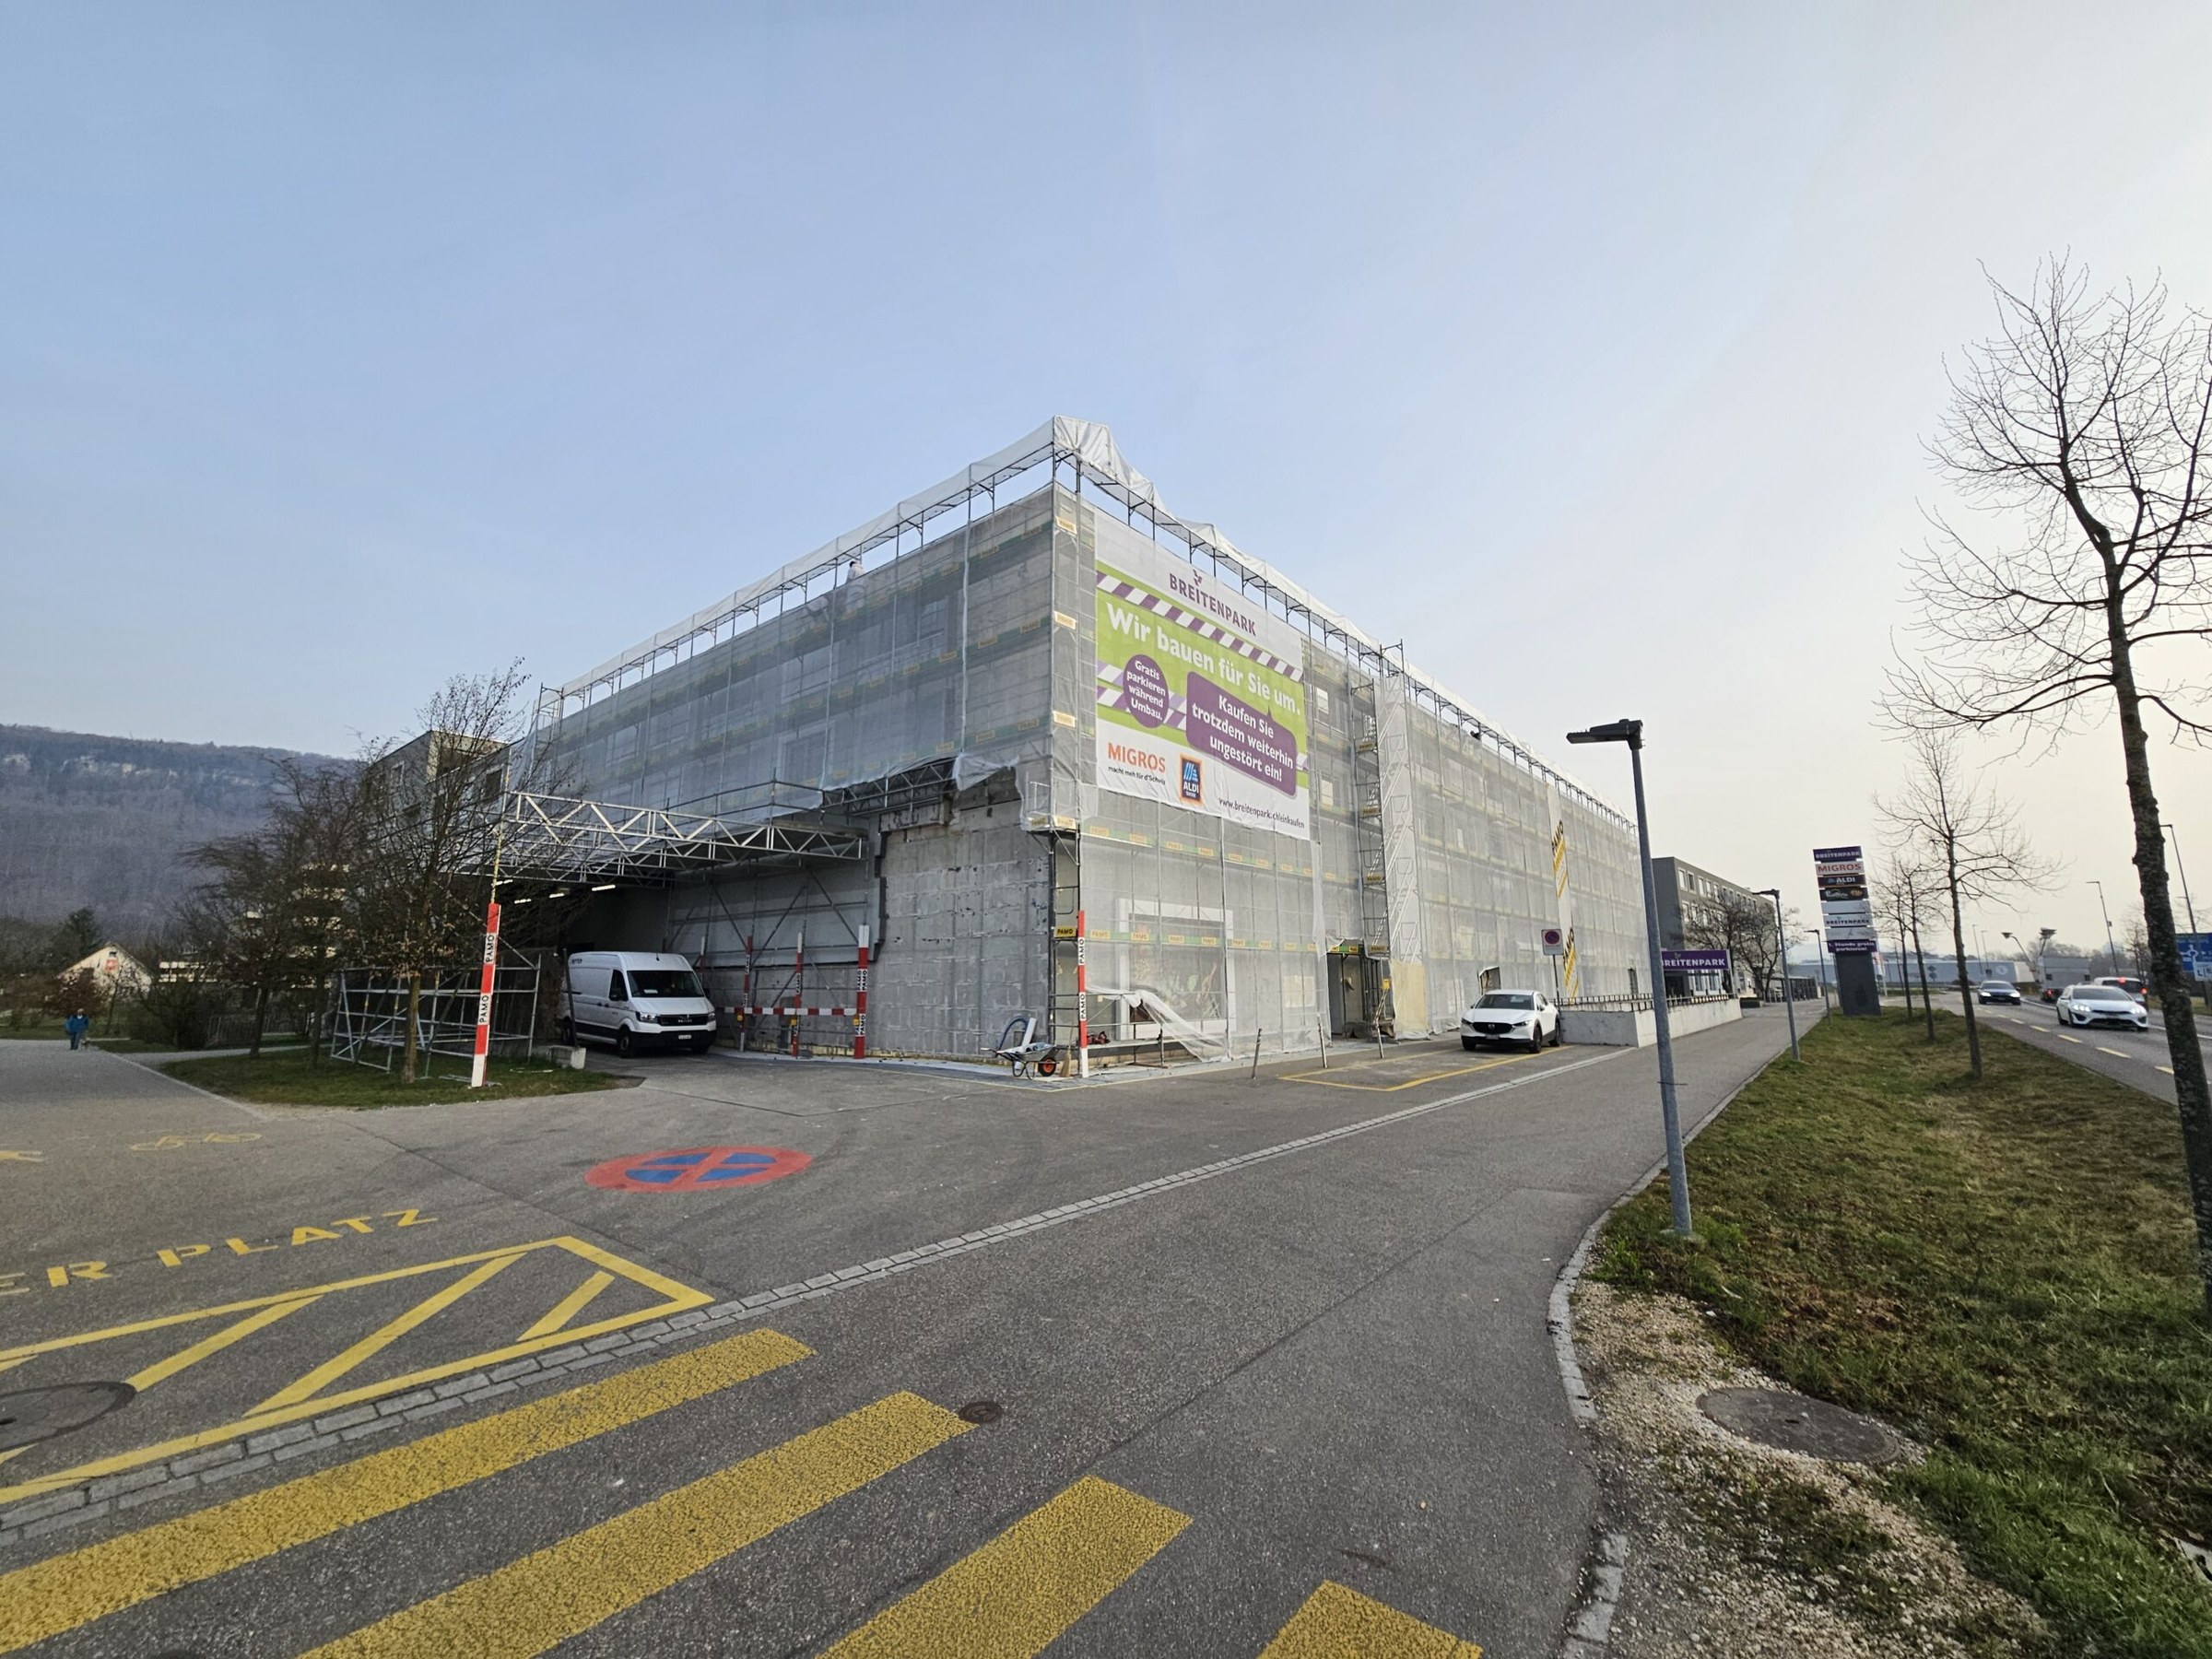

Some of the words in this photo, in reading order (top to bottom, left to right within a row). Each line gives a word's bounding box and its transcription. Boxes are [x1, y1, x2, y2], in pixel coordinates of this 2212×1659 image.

[1169, 572, 1256, 637] BREITENPARK
[1107, 602, 1151, 642] Wir
[1157, 626, 1215, 674] bauen
[1218, 657, 1244, 687] für
[1248, 673, 1270, 700] Sie
[1275, 690, 1300, 715] um.
[1135, 660, 1160, 680] Gratis
[1126, 671, 1166, 697] parkieren
[1128, 685, 1164, 709] während
[1131, 697, 1163, 721] Umbau.
[1218, 695, 1256, 729] Kaufen
[1258, 719, 1274, 738] Sie
[1192, 703, 1245, 744] trotzdem
[1247, 735, 1293, 770] weiterhin
[1108, 742, 1166, 773] MIGROS
[1209, 735, 1263, 772] ungestört
[1265, 764, 1282, 782] ein!
[1182, 781, 1199, 794] ALDI
[1218, 797, 1305, 829] www.breitenpark.ch/einkaufen
[1816, 851, 1861, 859] BREITENPARK
[1818, 864, 1862, 872] MIGROS
[486, 935, 495, 963] PAMO
[479, 994, 489, 1023] PAMO
[157, 1208, 439, 1268] PLATZ
